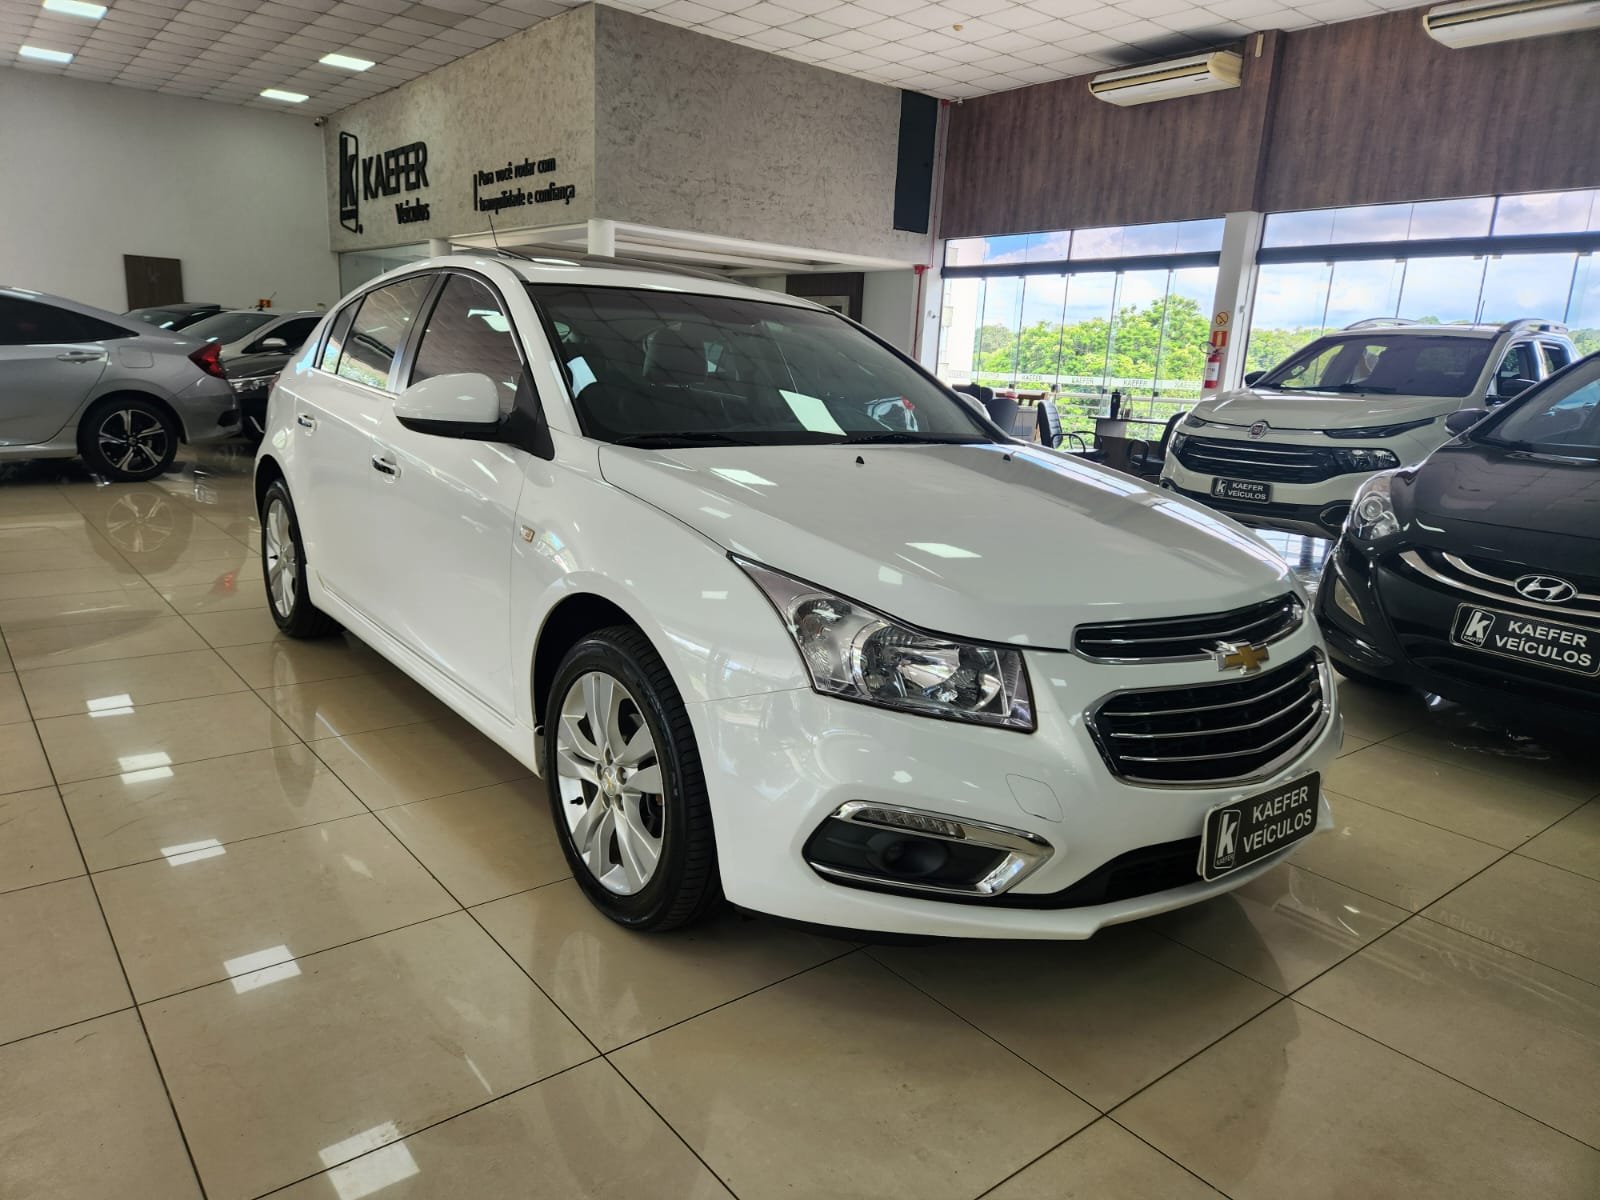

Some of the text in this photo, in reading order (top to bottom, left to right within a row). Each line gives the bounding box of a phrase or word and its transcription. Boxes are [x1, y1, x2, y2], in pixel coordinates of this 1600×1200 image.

[362, 142, 429, 200] KAEFER
[1232, 482, 1264, 492] KAEFER
[1495, 634, 1593, 667] VEÍCULOS
[1508, 620, 1588, 648] KAEFER
[1252, 785, 1308, 824] KAEFER
[1243, 808, 1312, 853] VEÍCULOS
